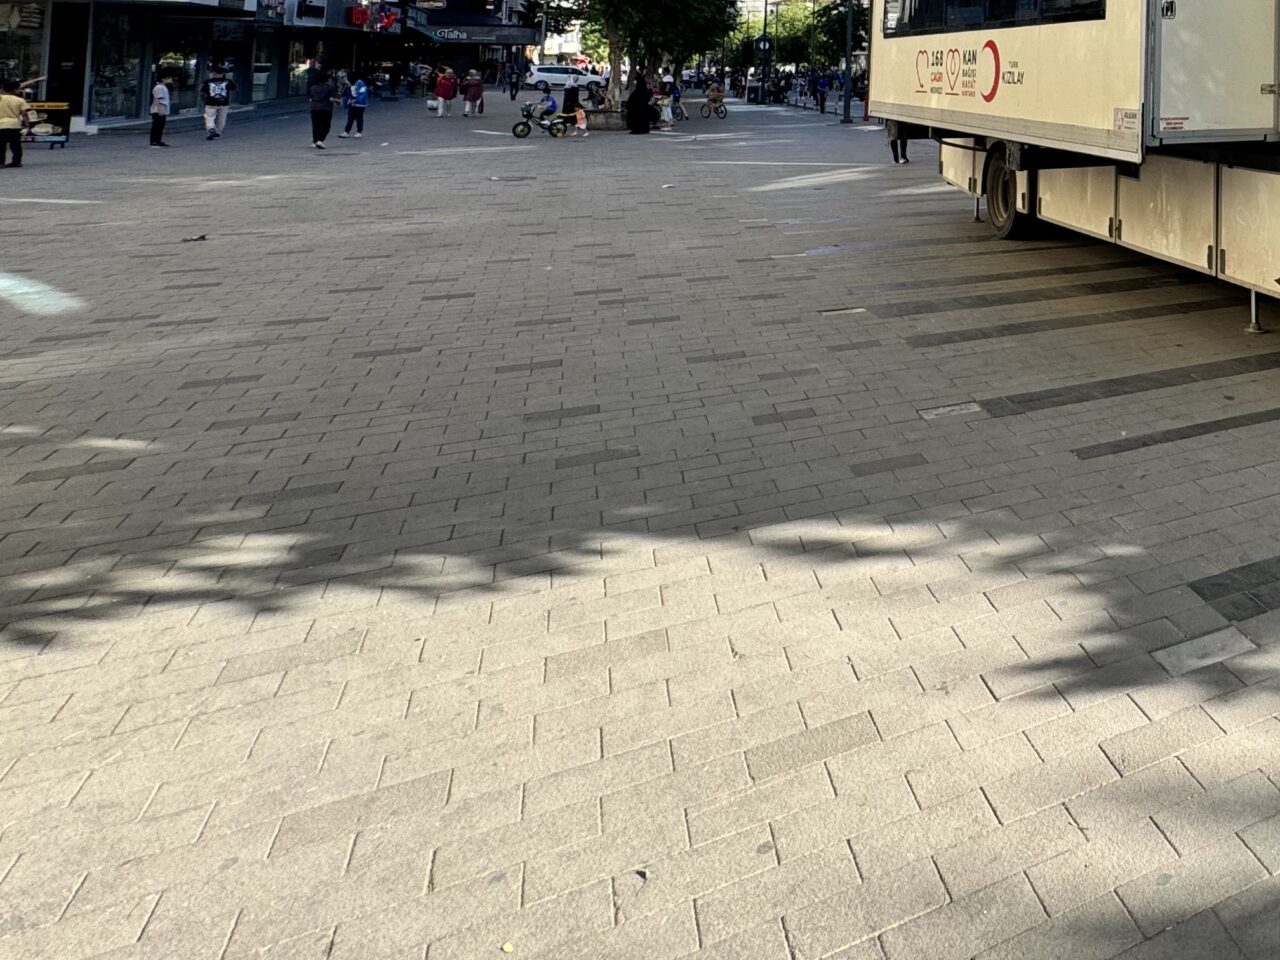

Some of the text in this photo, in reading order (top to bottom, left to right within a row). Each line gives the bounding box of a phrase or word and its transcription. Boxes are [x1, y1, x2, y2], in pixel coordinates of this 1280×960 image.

[931, 50, 944, 67] 168
[962, 49, 977, 66] KAN
[1001, 71, 1025, 85] KIZILAY
